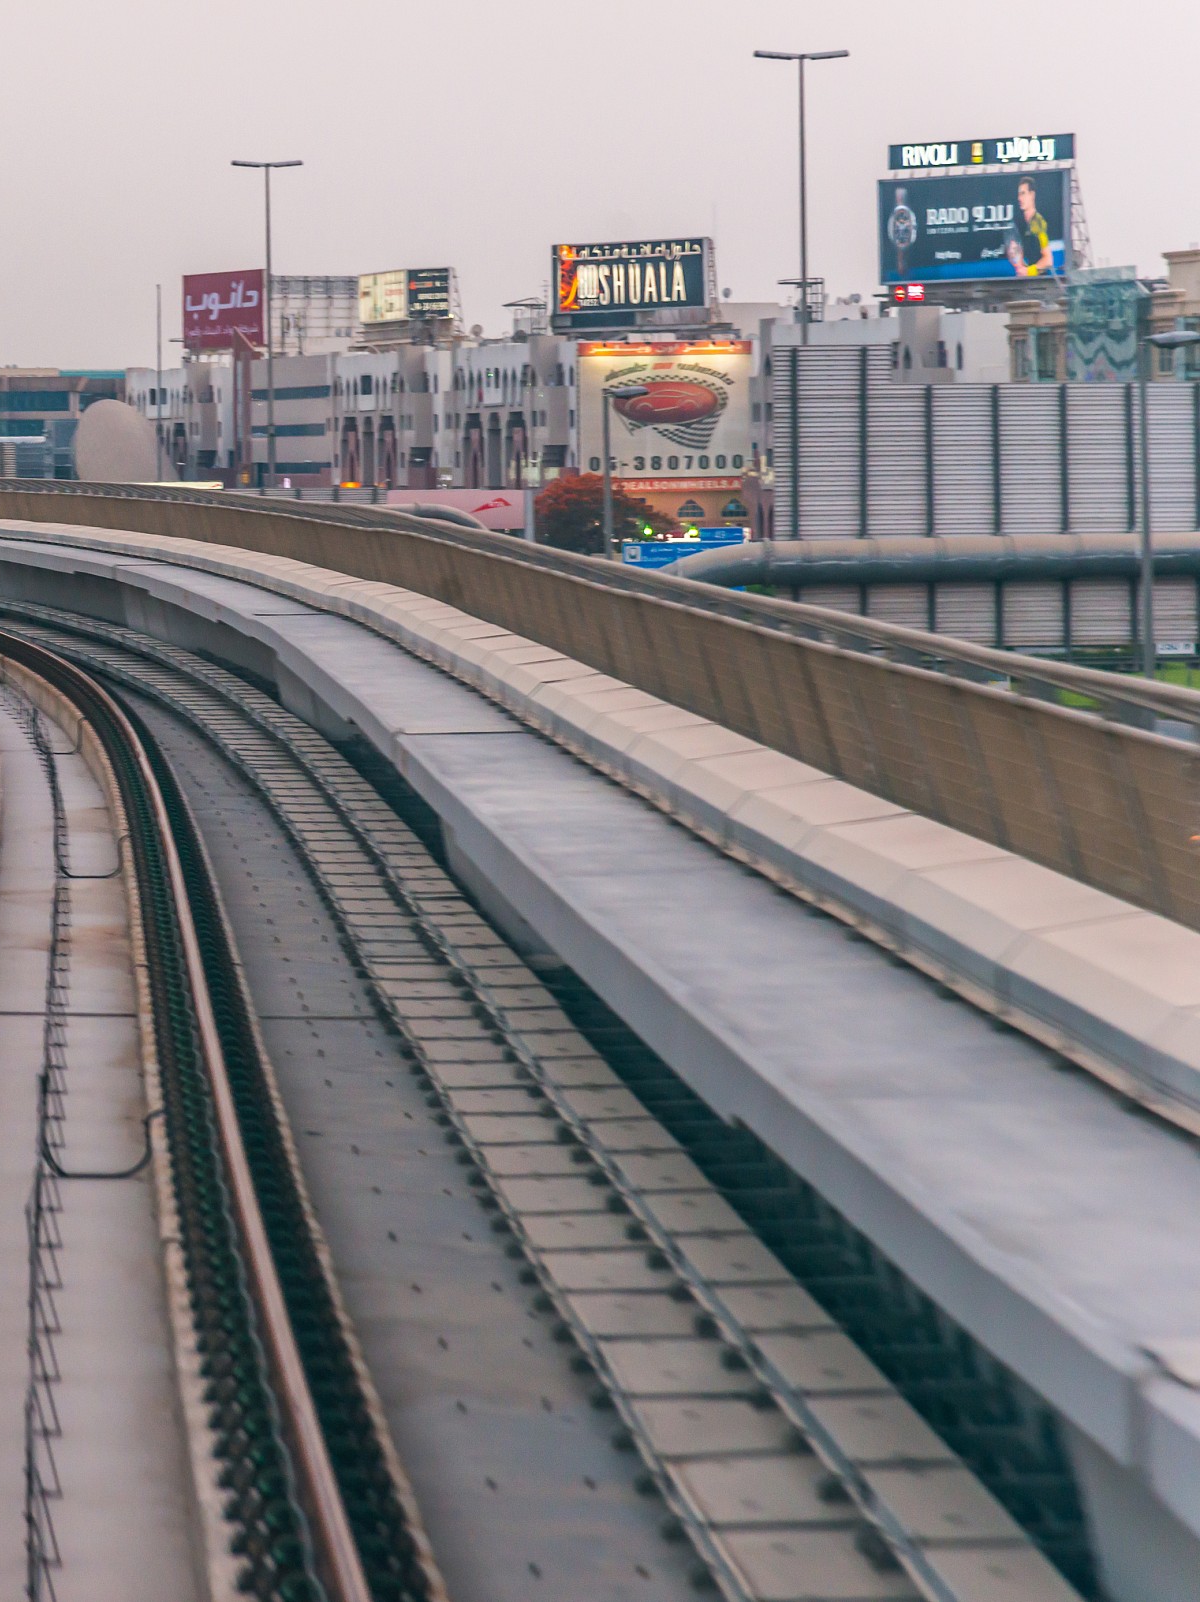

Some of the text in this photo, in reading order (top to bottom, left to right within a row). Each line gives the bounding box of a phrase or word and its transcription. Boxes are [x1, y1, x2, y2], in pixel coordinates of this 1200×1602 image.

[902, 143, 958, 167] RIVOLI
[926, 207, 969, 225] RADO
[598, 260, 687, 306] SHUALA
[185, 280, 259, 320] دانوب
